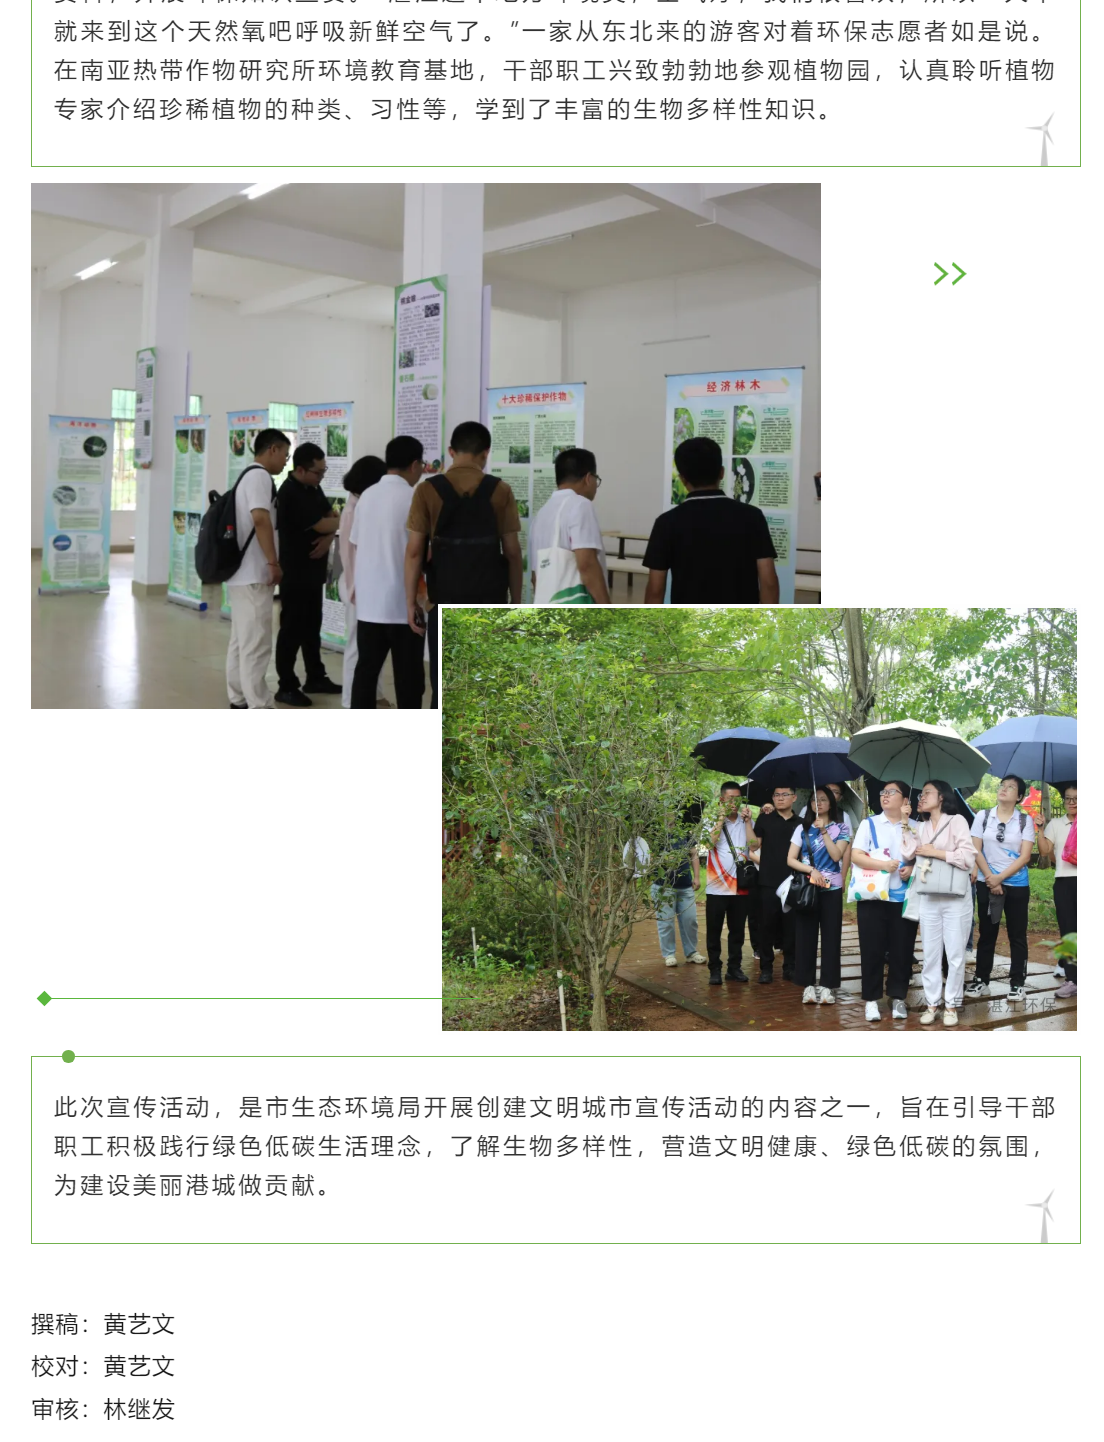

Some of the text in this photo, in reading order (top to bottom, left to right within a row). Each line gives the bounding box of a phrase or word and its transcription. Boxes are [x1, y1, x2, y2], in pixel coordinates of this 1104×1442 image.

[707, 379, 761, 392] 经济林木
[502, 391, 567, 404] 十大珍稀保护作物
